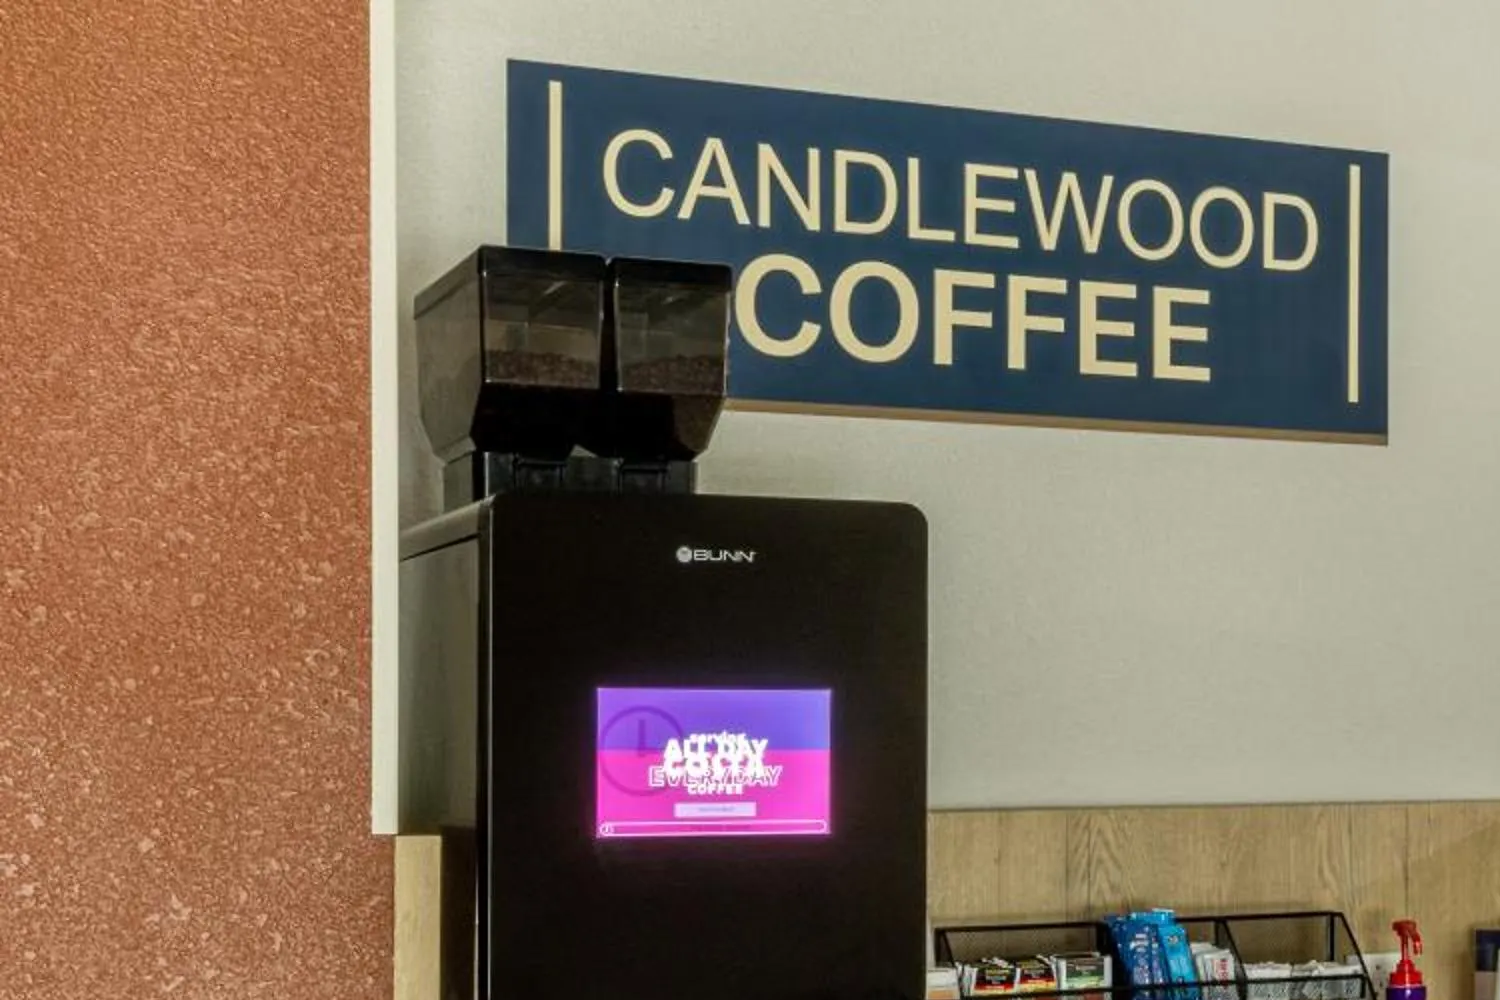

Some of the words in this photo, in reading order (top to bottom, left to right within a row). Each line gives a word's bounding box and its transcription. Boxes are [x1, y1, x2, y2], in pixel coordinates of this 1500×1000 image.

[601, 127, 1319, 272] CANDLEWOOD
[734, 254, 1212, 384] COFFEE
[693, 549, 757, 563] BUNN
